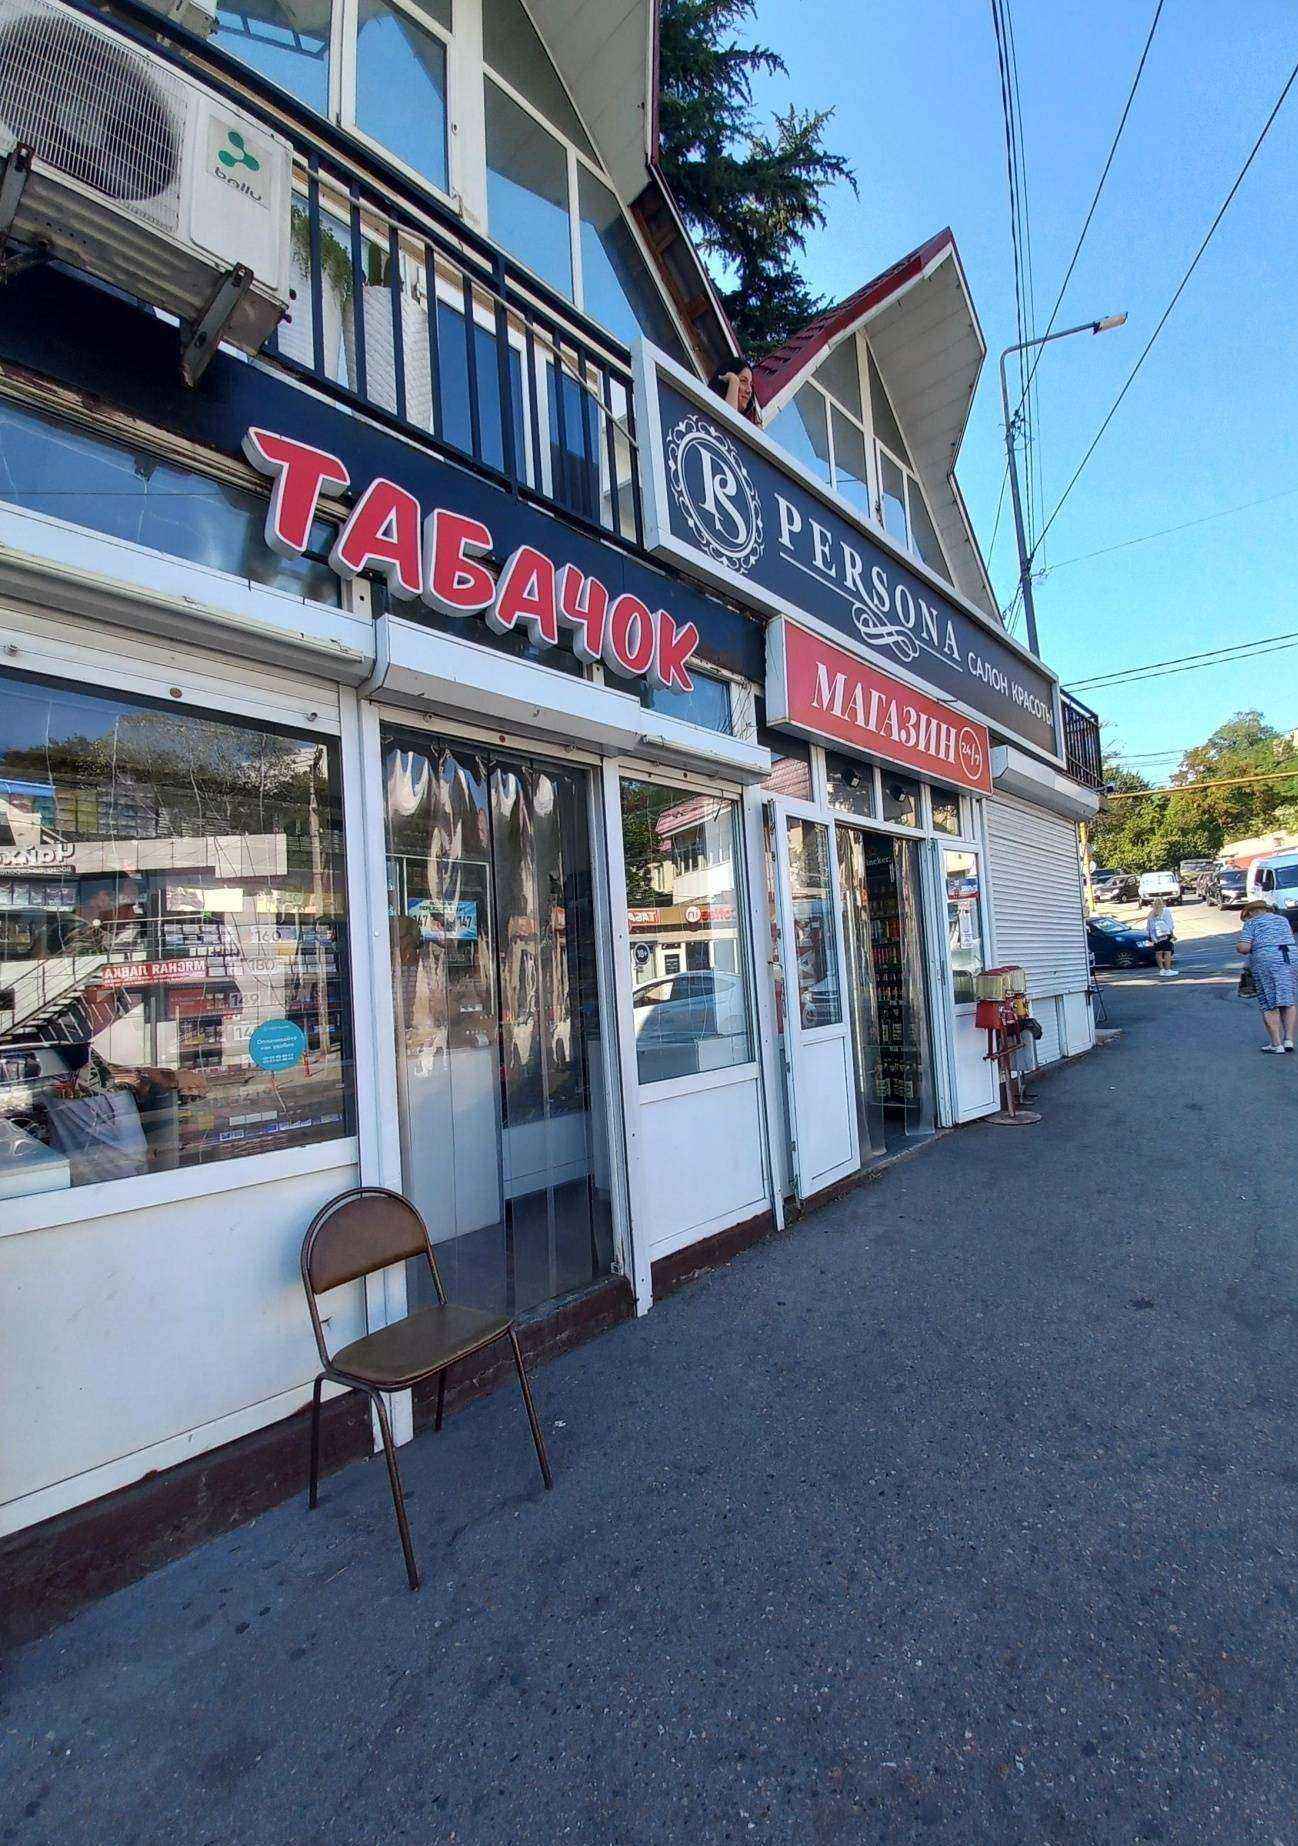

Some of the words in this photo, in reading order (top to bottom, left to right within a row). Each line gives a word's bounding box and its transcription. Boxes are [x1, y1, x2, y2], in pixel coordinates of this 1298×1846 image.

[242, 426, 699, 692] ТАБАЧОК
[773, 491, 961, 662] PERSONA
[812, 661, 958, 764] МАГАЗИН
[962, 742, 980, 766] 24/7
[968, 652, 1009, 697] САЛОН
[1011, 680, 1054, 728] КРАСОТЫ
